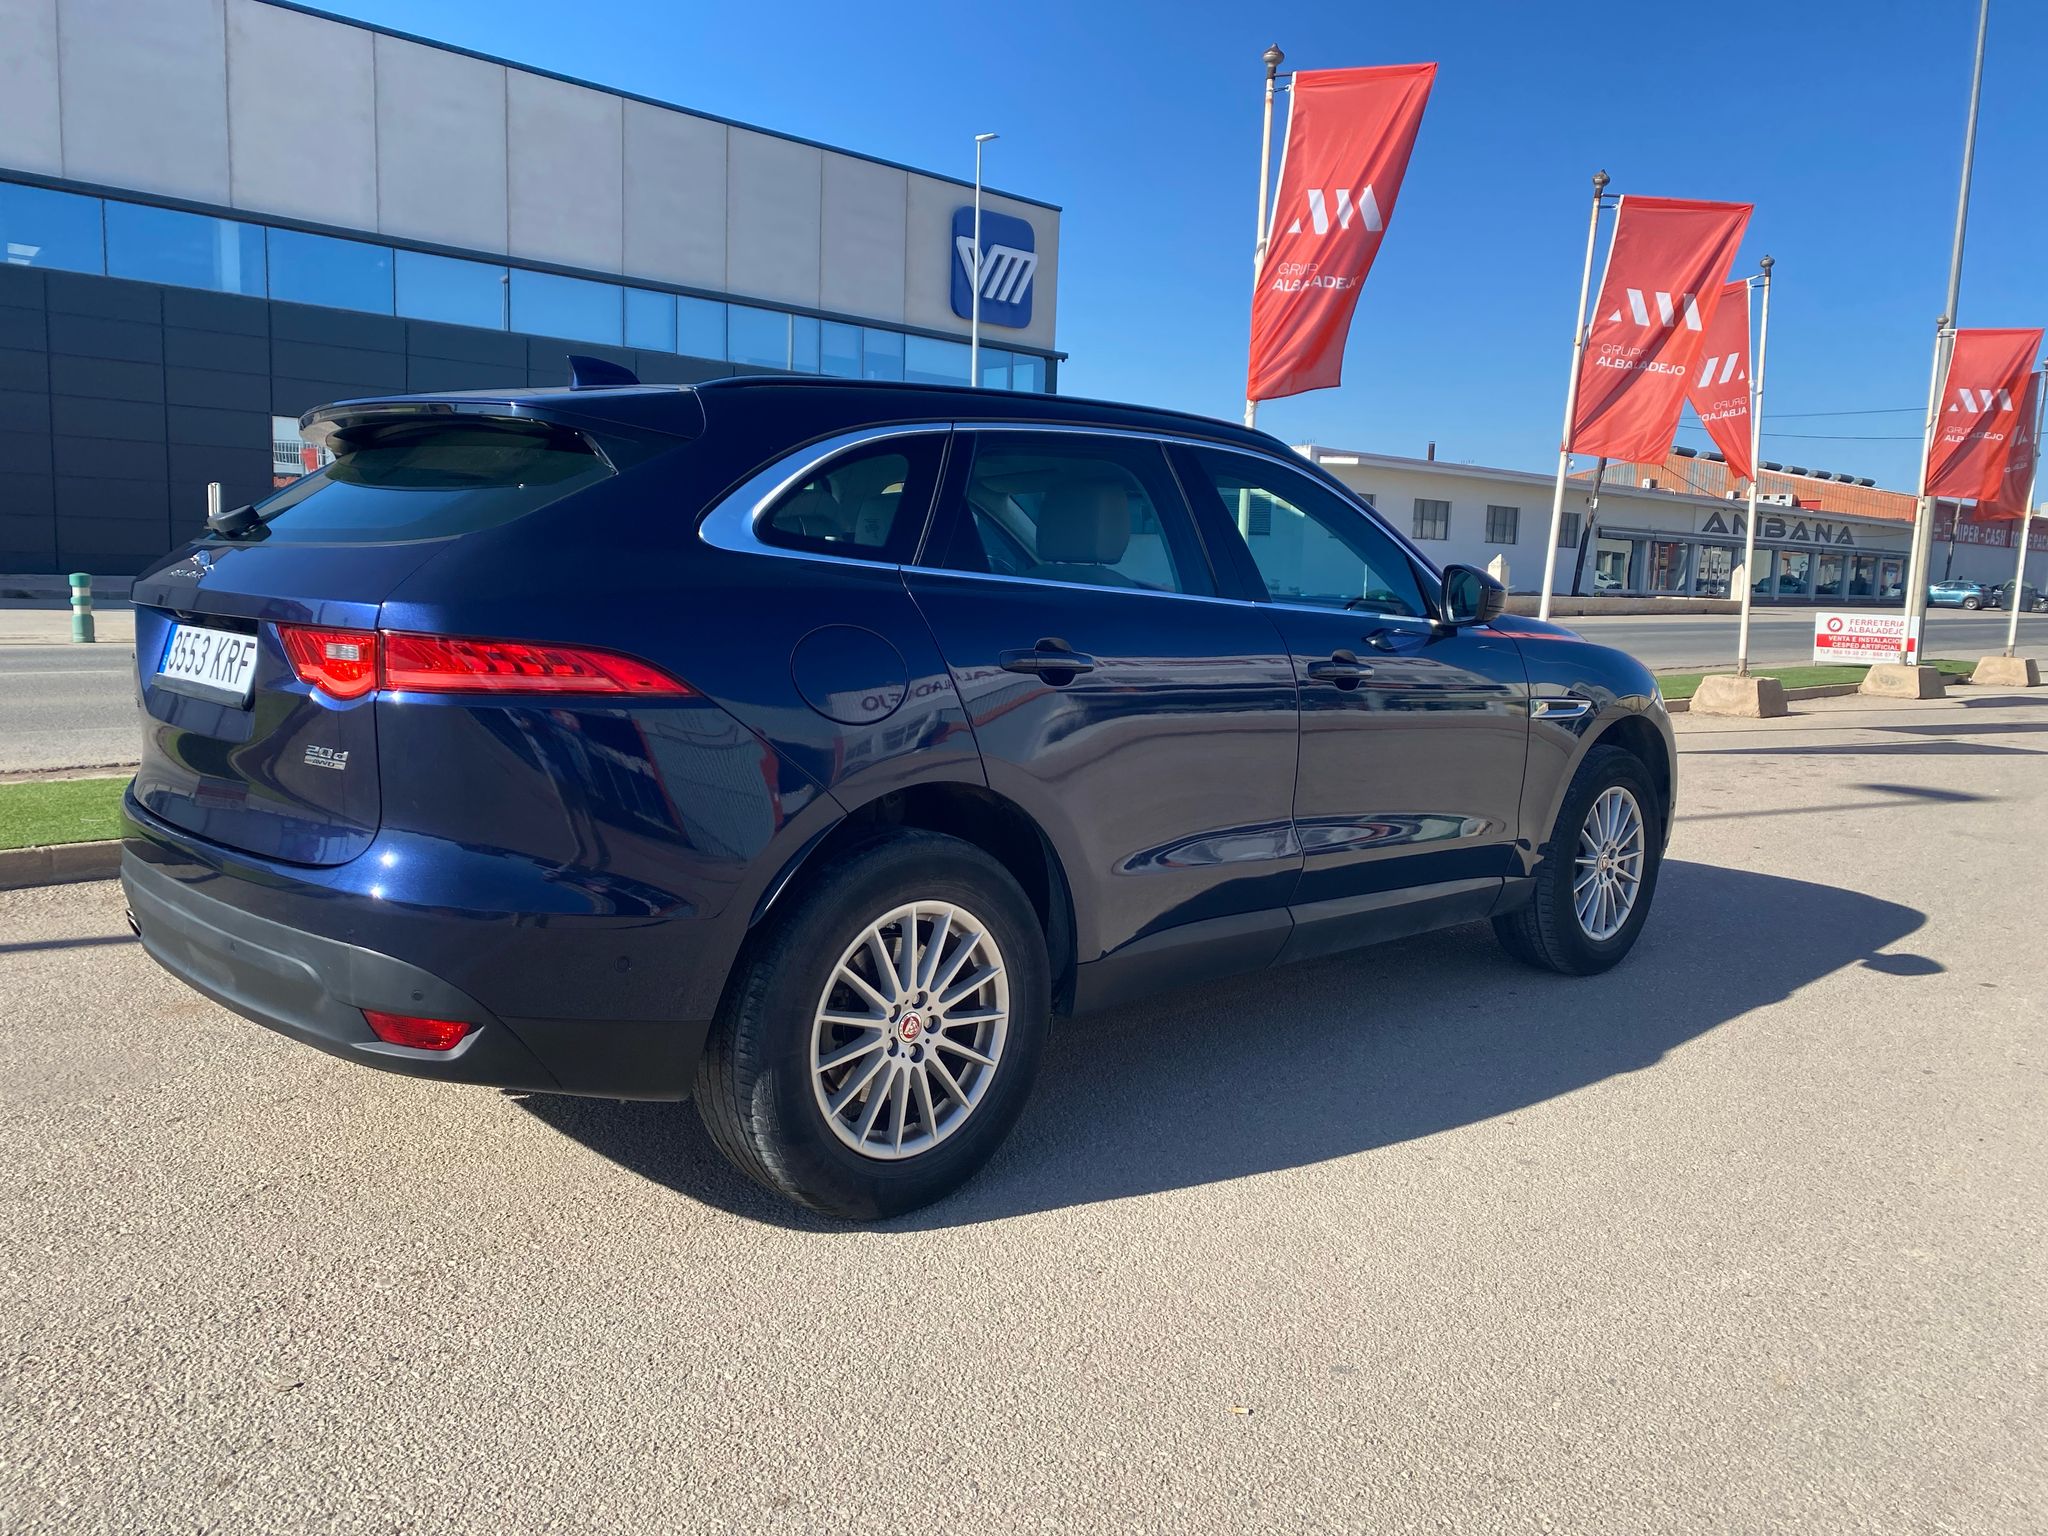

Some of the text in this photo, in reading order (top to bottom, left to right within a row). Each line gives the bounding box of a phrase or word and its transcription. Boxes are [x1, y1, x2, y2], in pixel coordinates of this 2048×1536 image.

[1277, 262, 1319, 276] GRUP
[1596, 356, 1686, 376] ALBALADEJO
[1702, 510, 1855, 545] ANIBANA
[1849, 618, 1904, 627] FERRETERIA
[1832, 641, 1900, 651] CESPED ARTIFICIAL
[1858, 637, 1901, 645] INSTALACIO
[168, 630, 256, 684] 3553 KRF
[305, 744, 349, 762] 20d
